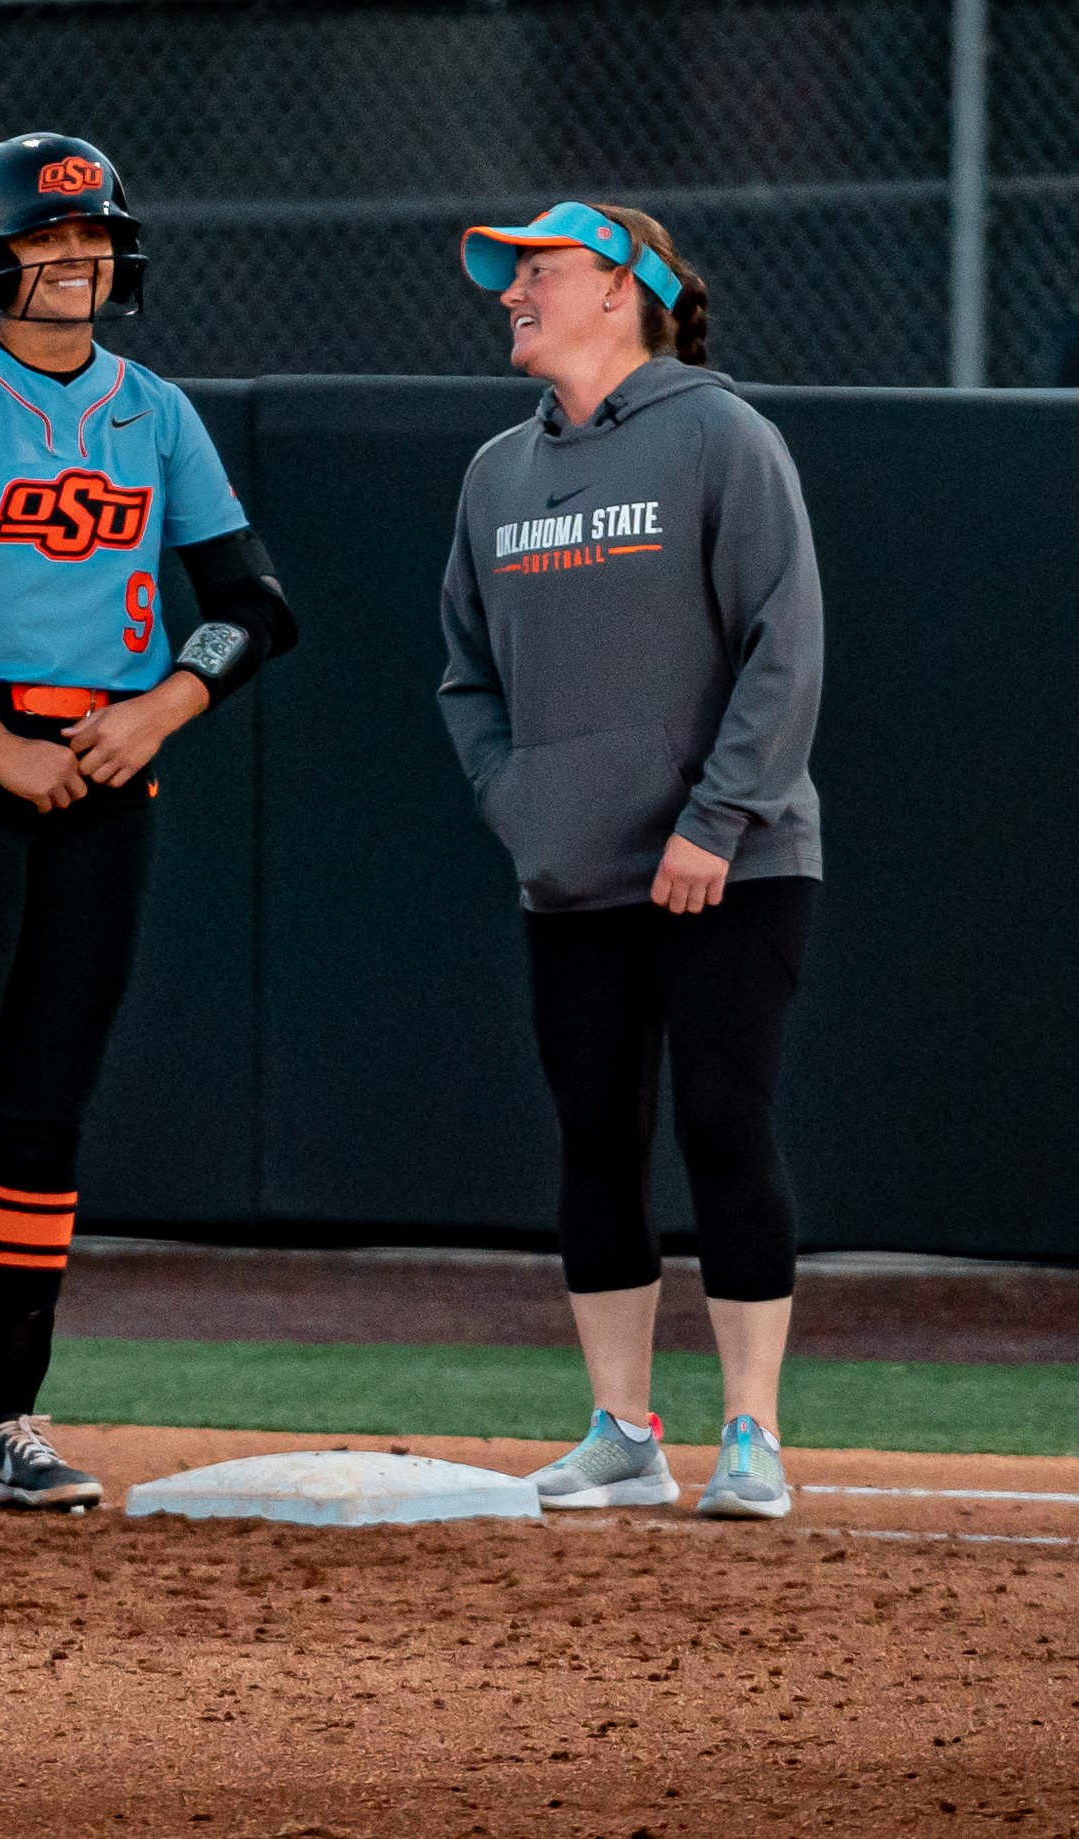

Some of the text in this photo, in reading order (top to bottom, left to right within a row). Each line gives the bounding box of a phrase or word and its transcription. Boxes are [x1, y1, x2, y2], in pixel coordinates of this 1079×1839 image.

[38, 156, 104, 196] OSU
[495, 501, 663, 557] OKLAHOMA STATE
[522, 544, 605, 575] SOFTBALL
[122, 570, 157, 653] 9
